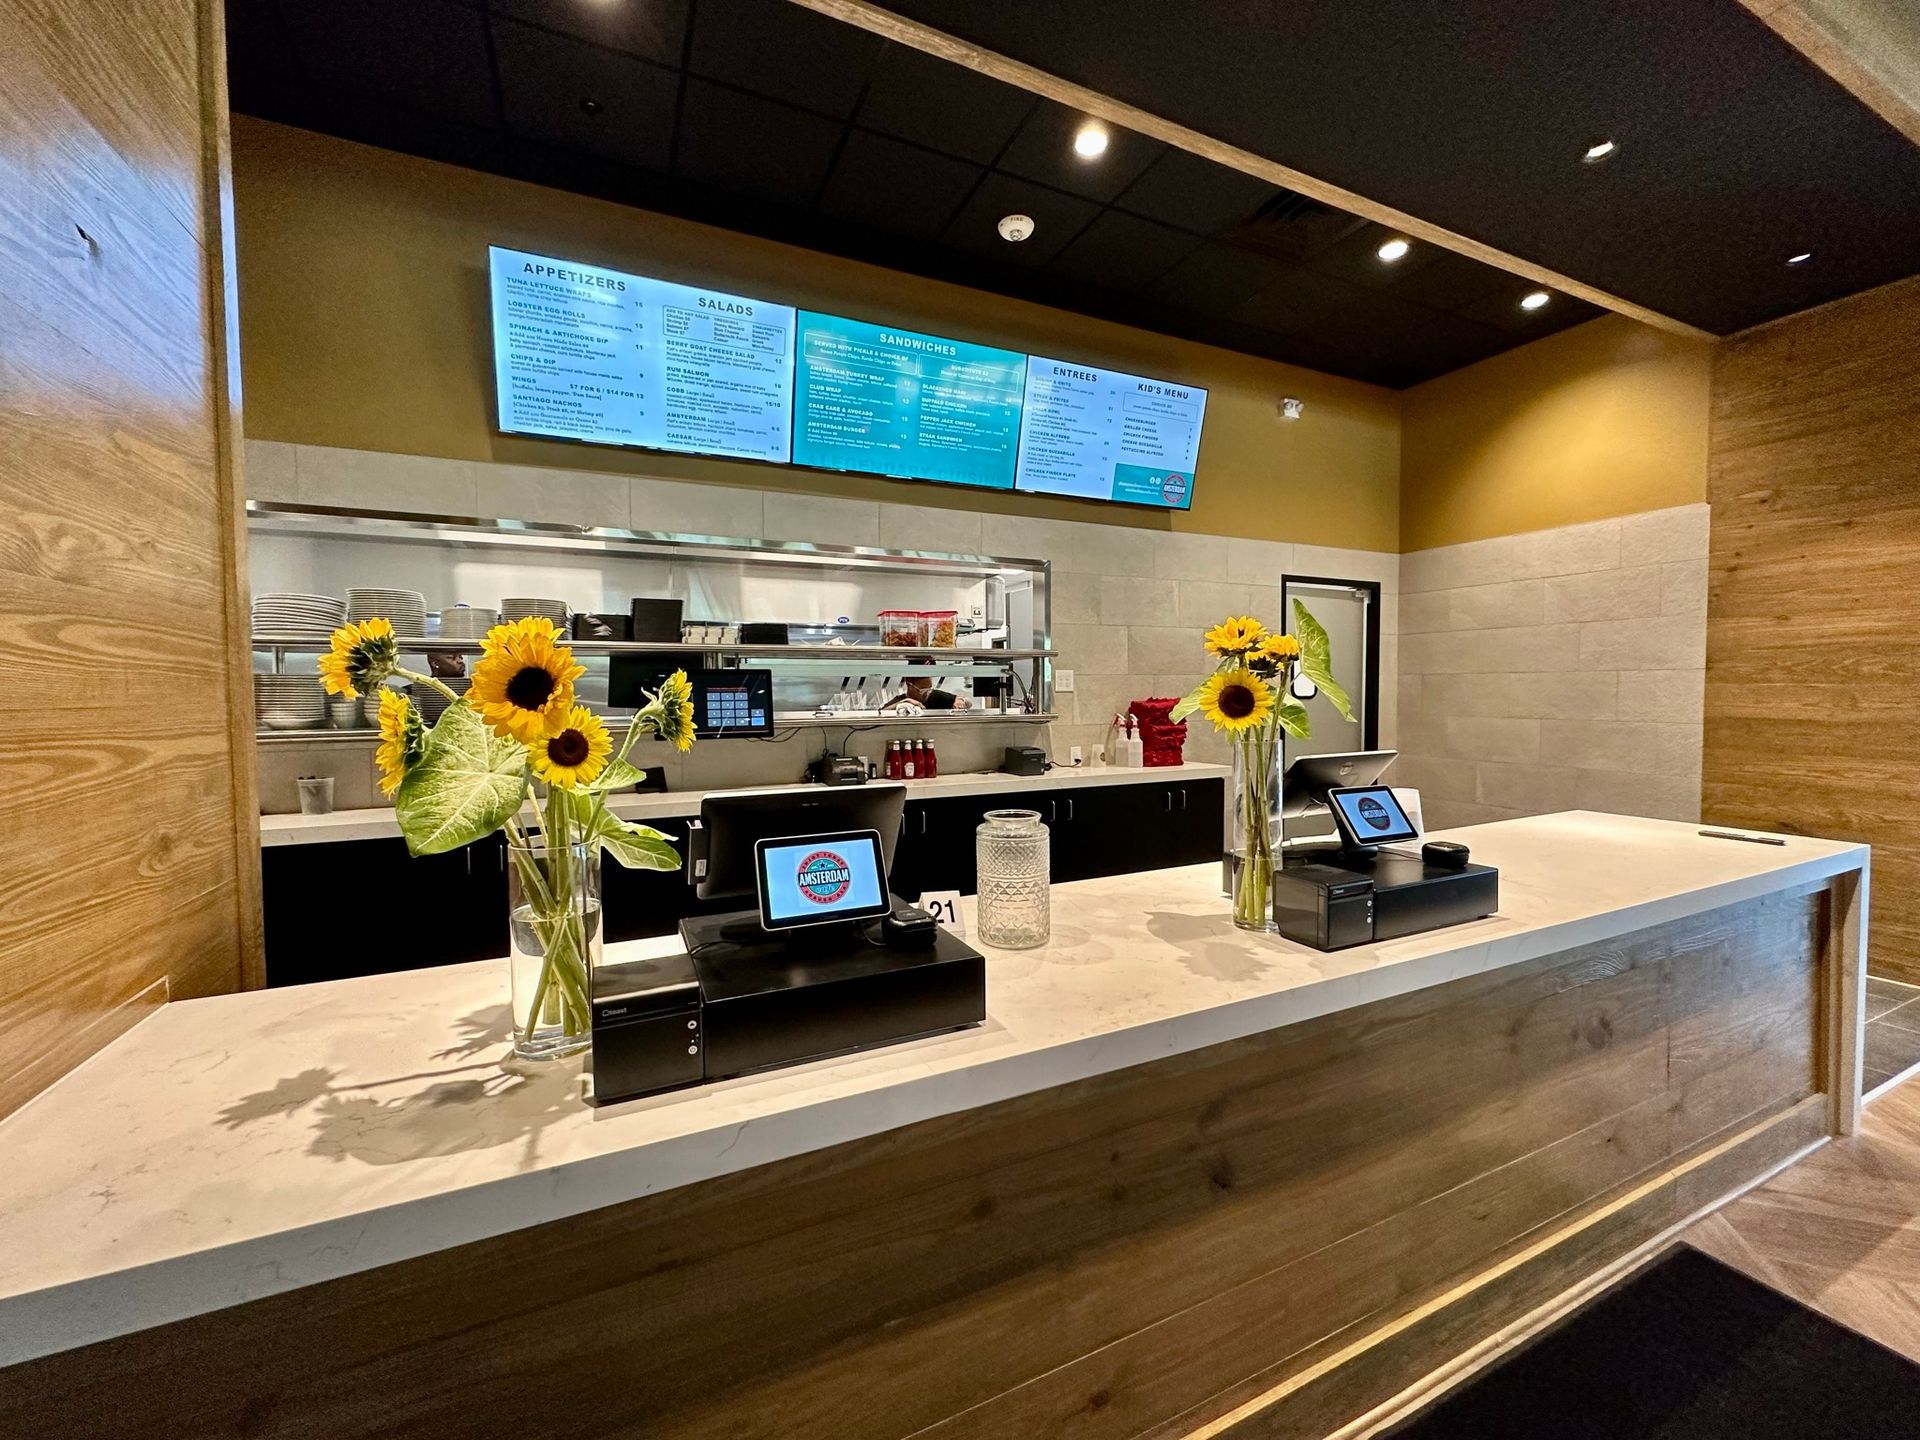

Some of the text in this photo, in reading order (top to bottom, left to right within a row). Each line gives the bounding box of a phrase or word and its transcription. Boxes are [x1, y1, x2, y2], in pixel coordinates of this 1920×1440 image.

[506, 276, 527, 286] TUNA
[530, 281, 563, 293] LETTUCE
[522, 261, 626, 292] APPETIZERS
[507, 299, 585, 318] LOBSTER EGG ROLLS
[698, 296, 753, 316] SALADS
[508, 322, 542, 333] SPINACH
[552, 329, 593, 342] ARTICHOKE
[666, 339, 687, 348] BERRY
[709, 347, 732, 355] CHEESE
[879, 333, 956, 356] SANDWICHES
[510, 353, 532, 362] CHIPS
[511, 375, 536, 384] WINGS
[683, 368, 709, 377] SALMON
[1053, 366, 1097, 382] ENTREES
[1137, 382, 1189, 399] KID'S MENU
[512, 393, 582, 408] SANTIAGO NACHOS
[666, 412, 706, 422] AMSTERDAM
[800, 869, 849, 886] AMSTERDAM
[930, 900, 955, 924] 21
